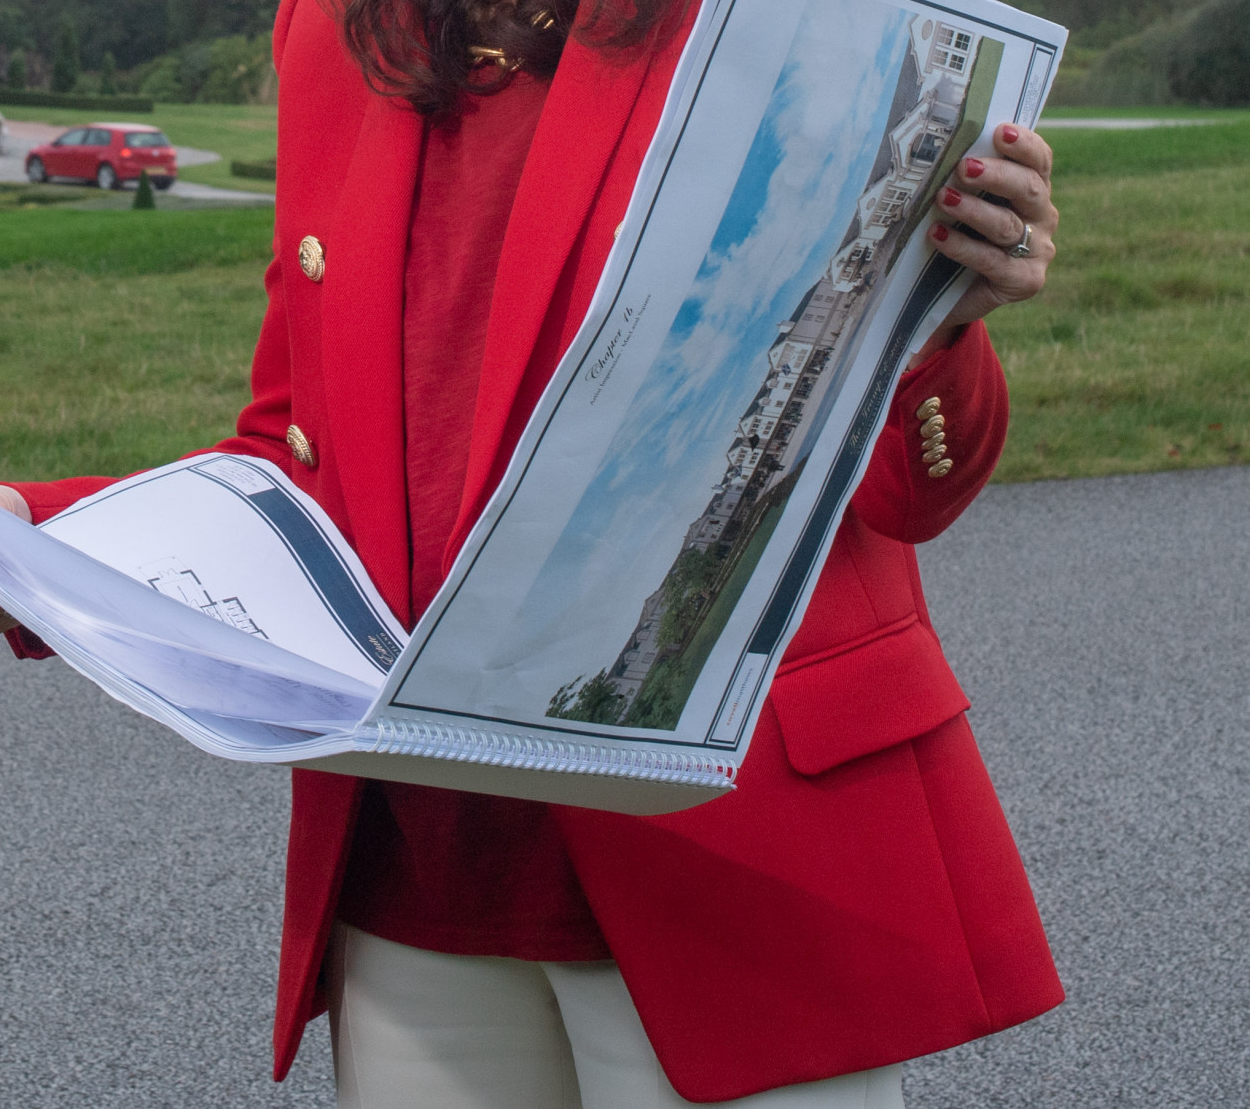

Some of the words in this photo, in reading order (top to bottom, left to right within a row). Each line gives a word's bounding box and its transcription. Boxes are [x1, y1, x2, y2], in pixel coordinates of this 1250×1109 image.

[584, 328, 622, 381] Chapter
[623, 307, 633, 322] 1b
[590, 387, 602, 406] Artist
[599, 352, 622, 387] Impression
[637, 294, 651, 317] Square
